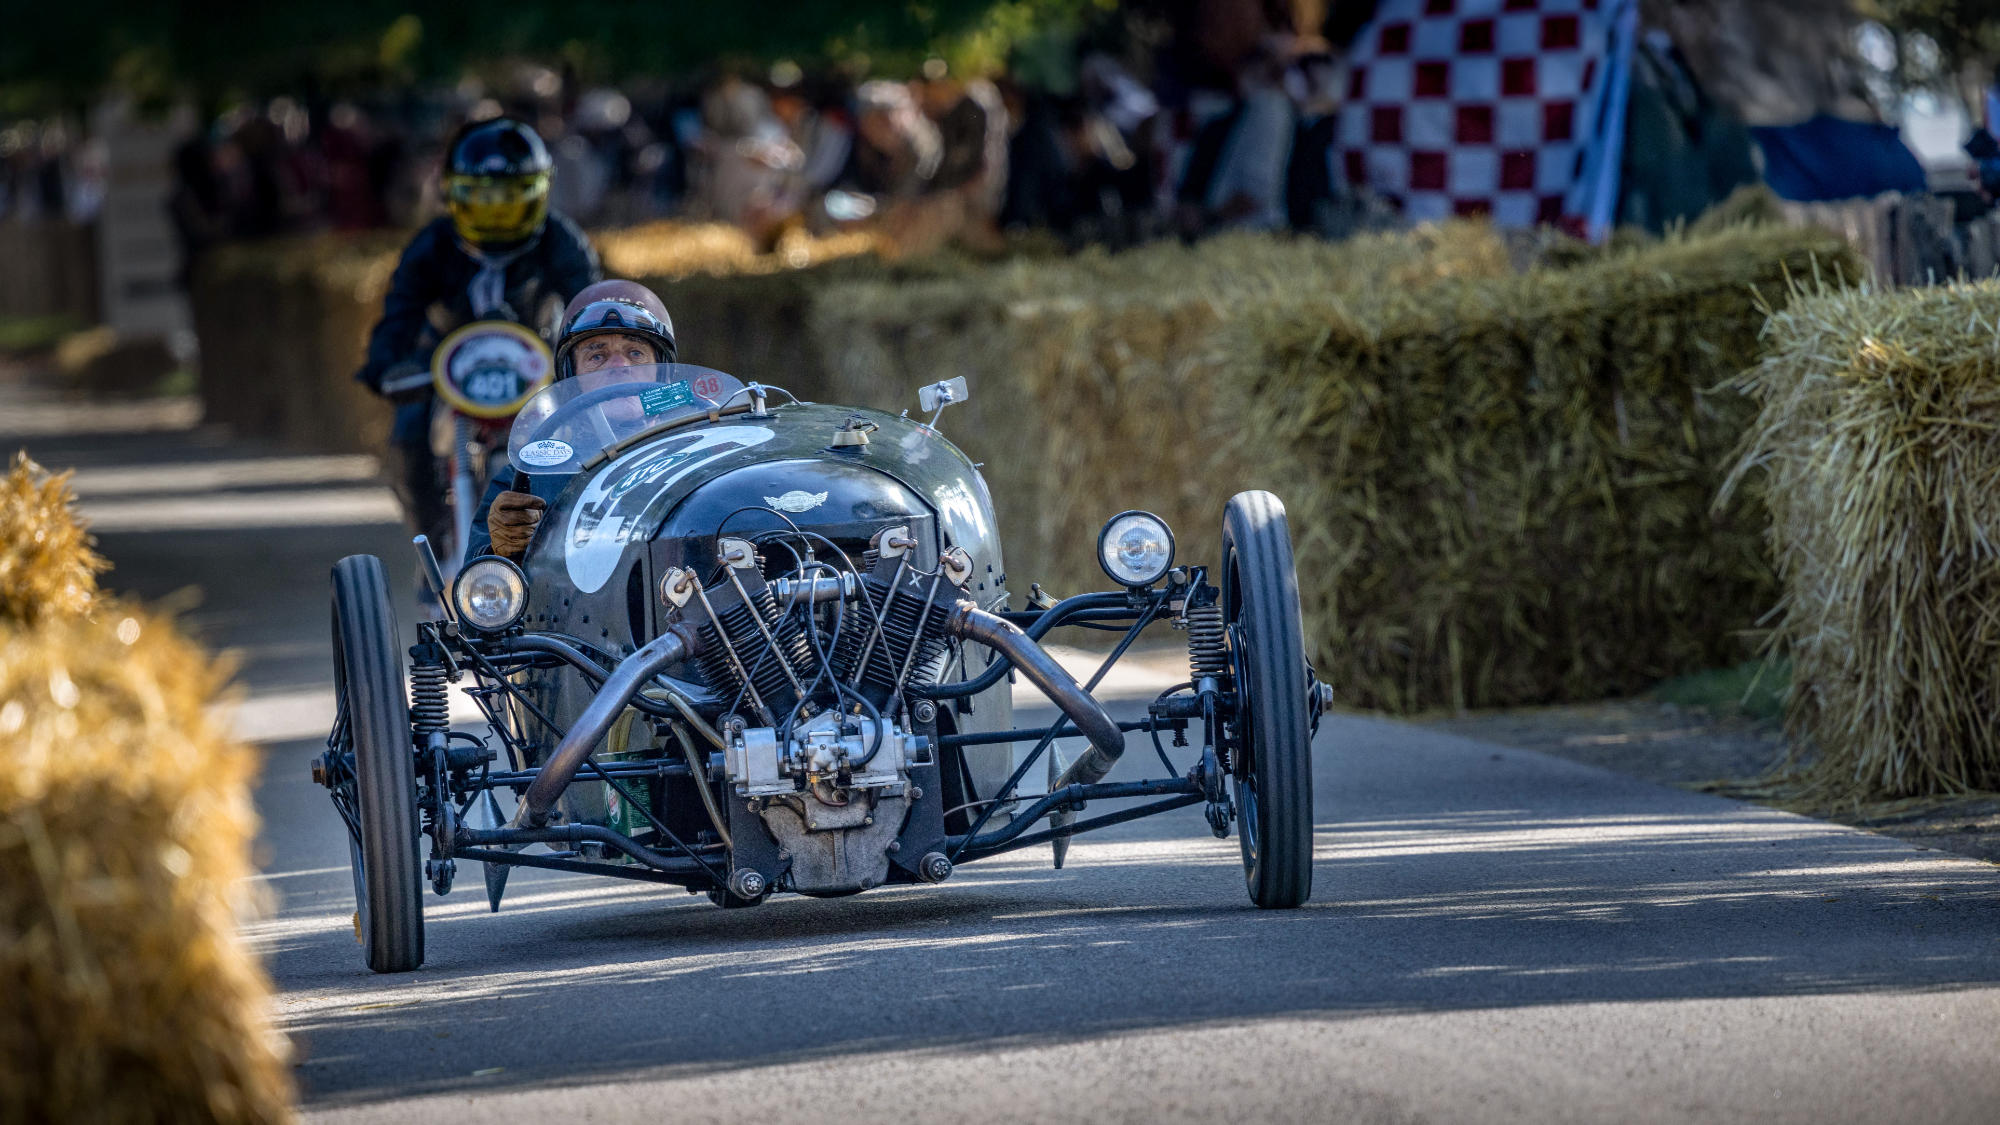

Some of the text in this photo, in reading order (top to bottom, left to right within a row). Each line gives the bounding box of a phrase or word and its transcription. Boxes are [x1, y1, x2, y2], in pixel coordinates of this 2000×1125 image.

[466, 371, 518, 399] 401
[697, 377, 720, 396] 38
[520, 449, 552, 457] CLASSIC
[620, 457, 675, 490] 410
